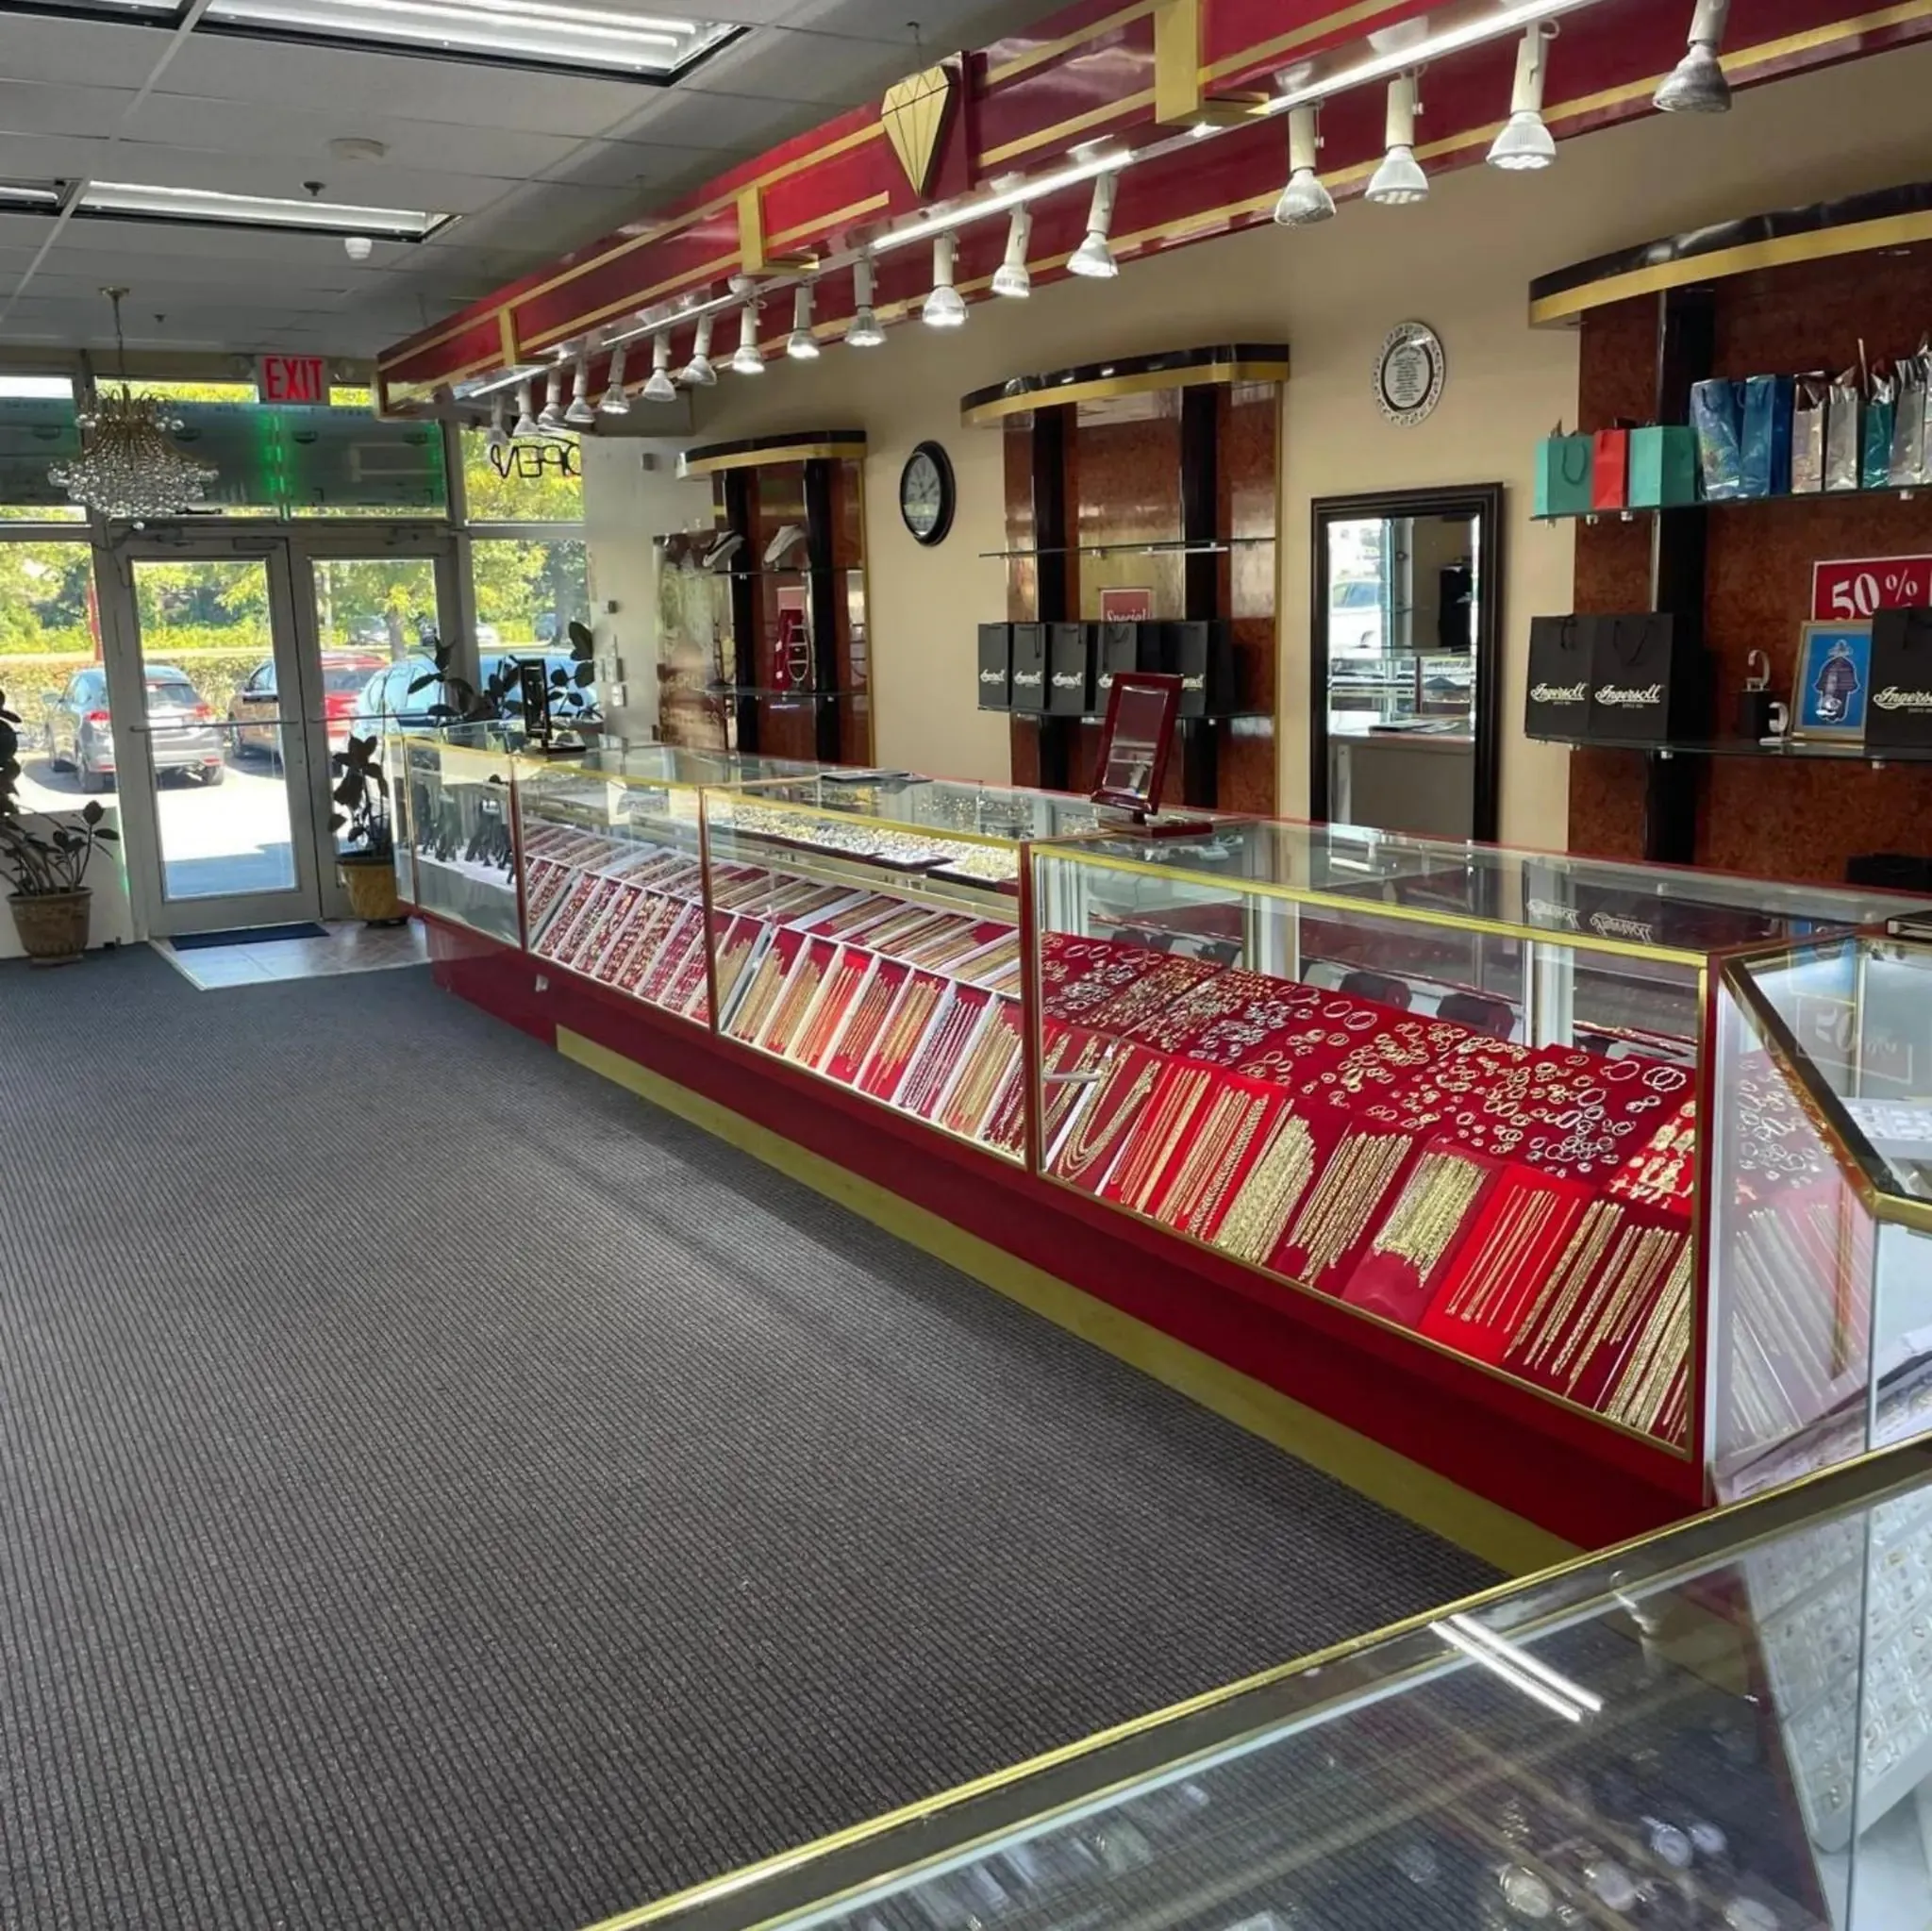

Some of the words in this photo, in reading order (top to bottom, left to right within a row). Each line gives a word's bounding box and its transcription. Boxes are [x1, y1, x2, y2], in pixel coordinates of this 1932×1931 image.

[264, 358, 323, 402] EXIT
[1530, 681, 1588, 703] Ingersoll
[1594, 683, 1663, 706] Ingersoll
[1873, 686, 1932, 709] Ingers
